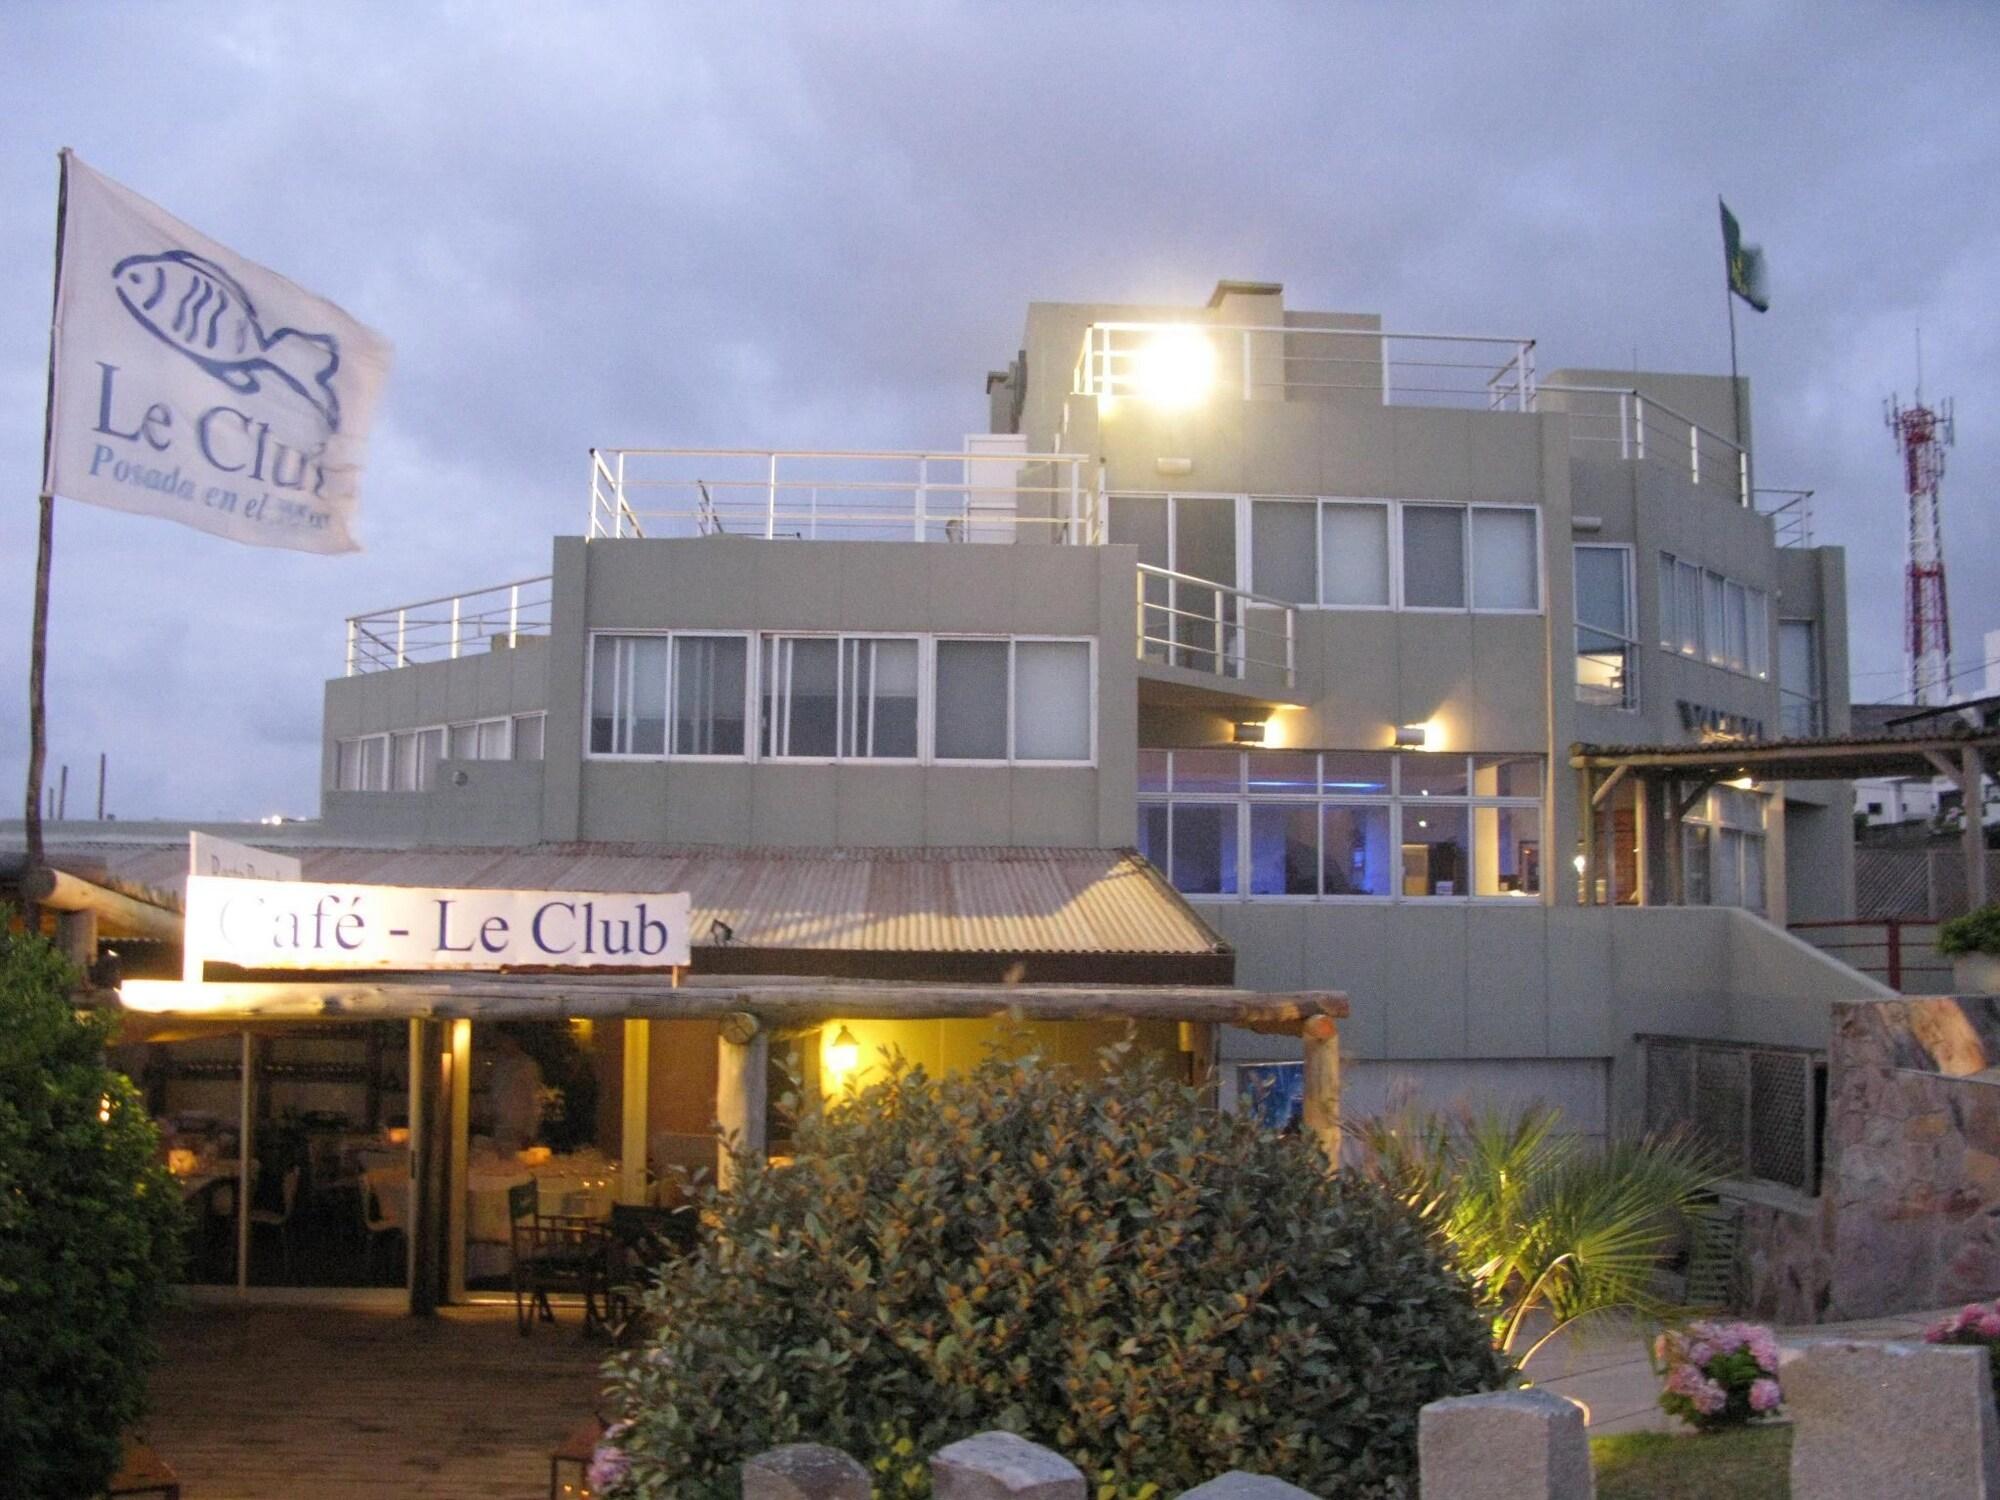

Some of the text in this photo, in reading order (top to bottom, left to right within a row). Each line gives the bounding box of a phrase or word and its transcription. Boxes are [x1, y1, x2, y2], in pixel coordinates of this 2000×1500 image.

[92, 361, 172, 451] Le
[88, 443, 197, 501] Posada
[205, 486, 238, 513] en
[244, 493, 269, 522] el
[220, 895, 365, 951] Café
[433, 899, 509, 953] Le
[532, 902, 668, 956] Club
